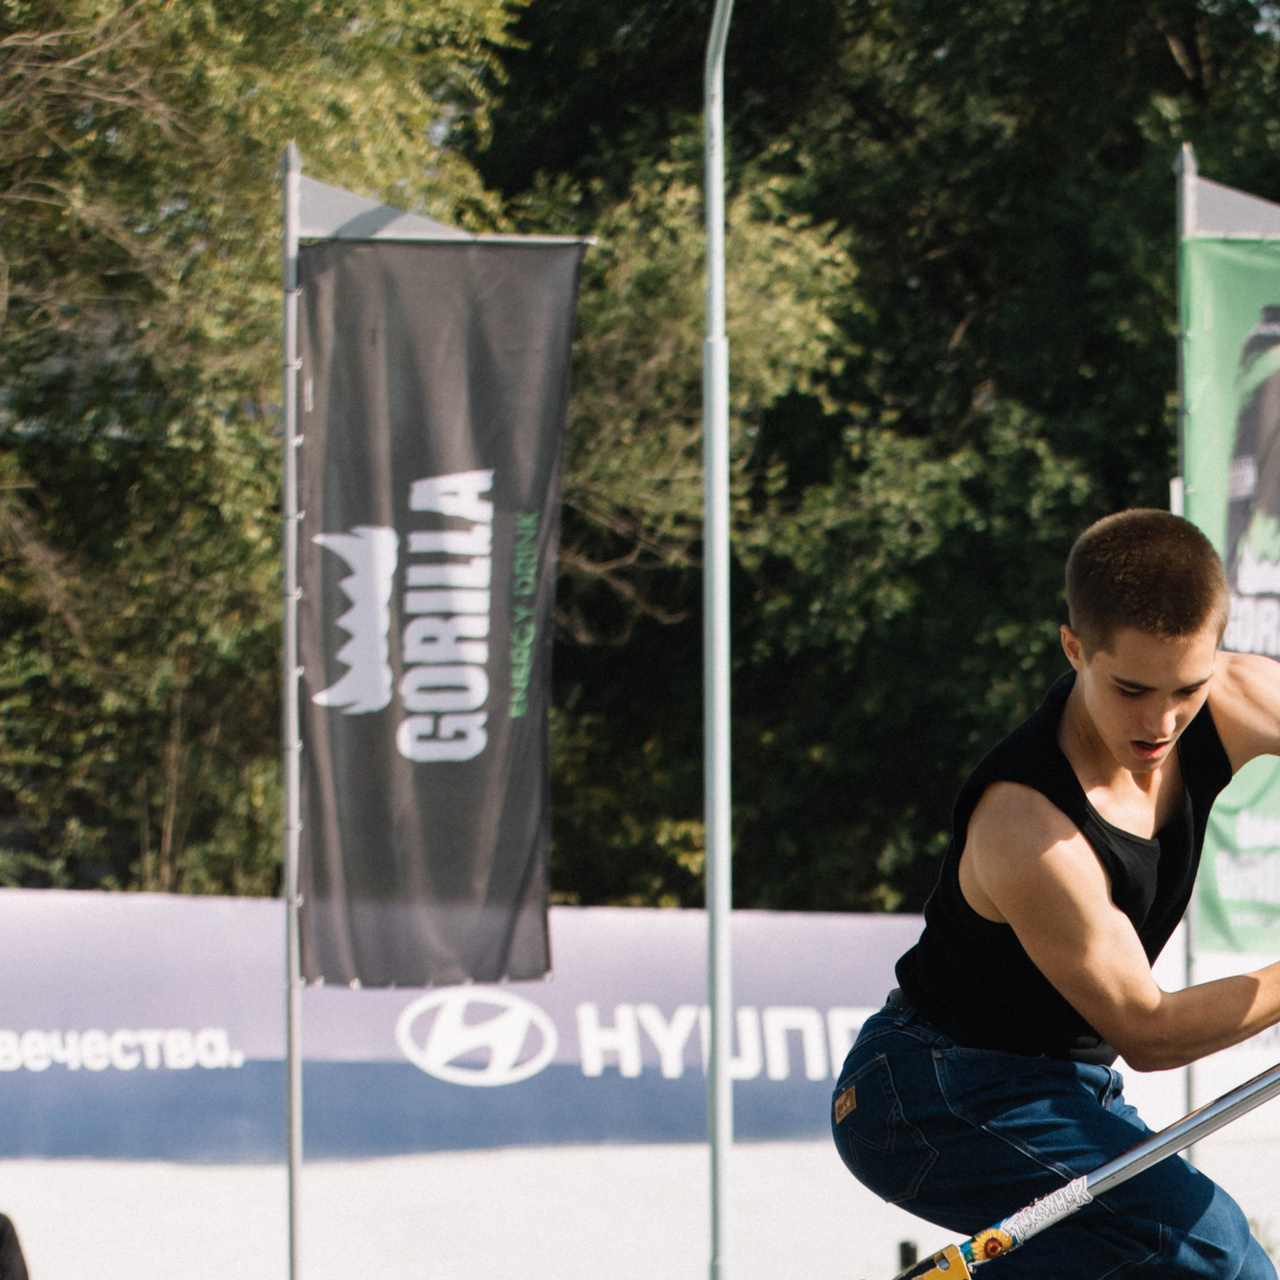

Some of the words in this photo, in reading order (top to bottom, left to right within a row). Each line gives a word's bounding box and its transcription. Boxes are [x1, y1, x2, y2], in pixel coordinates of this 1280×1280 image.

[513, 511, 540, 595] DRINK
[396, 468, 495, 763] GORILLA
[508, 604, 537, 718] ENERGY
